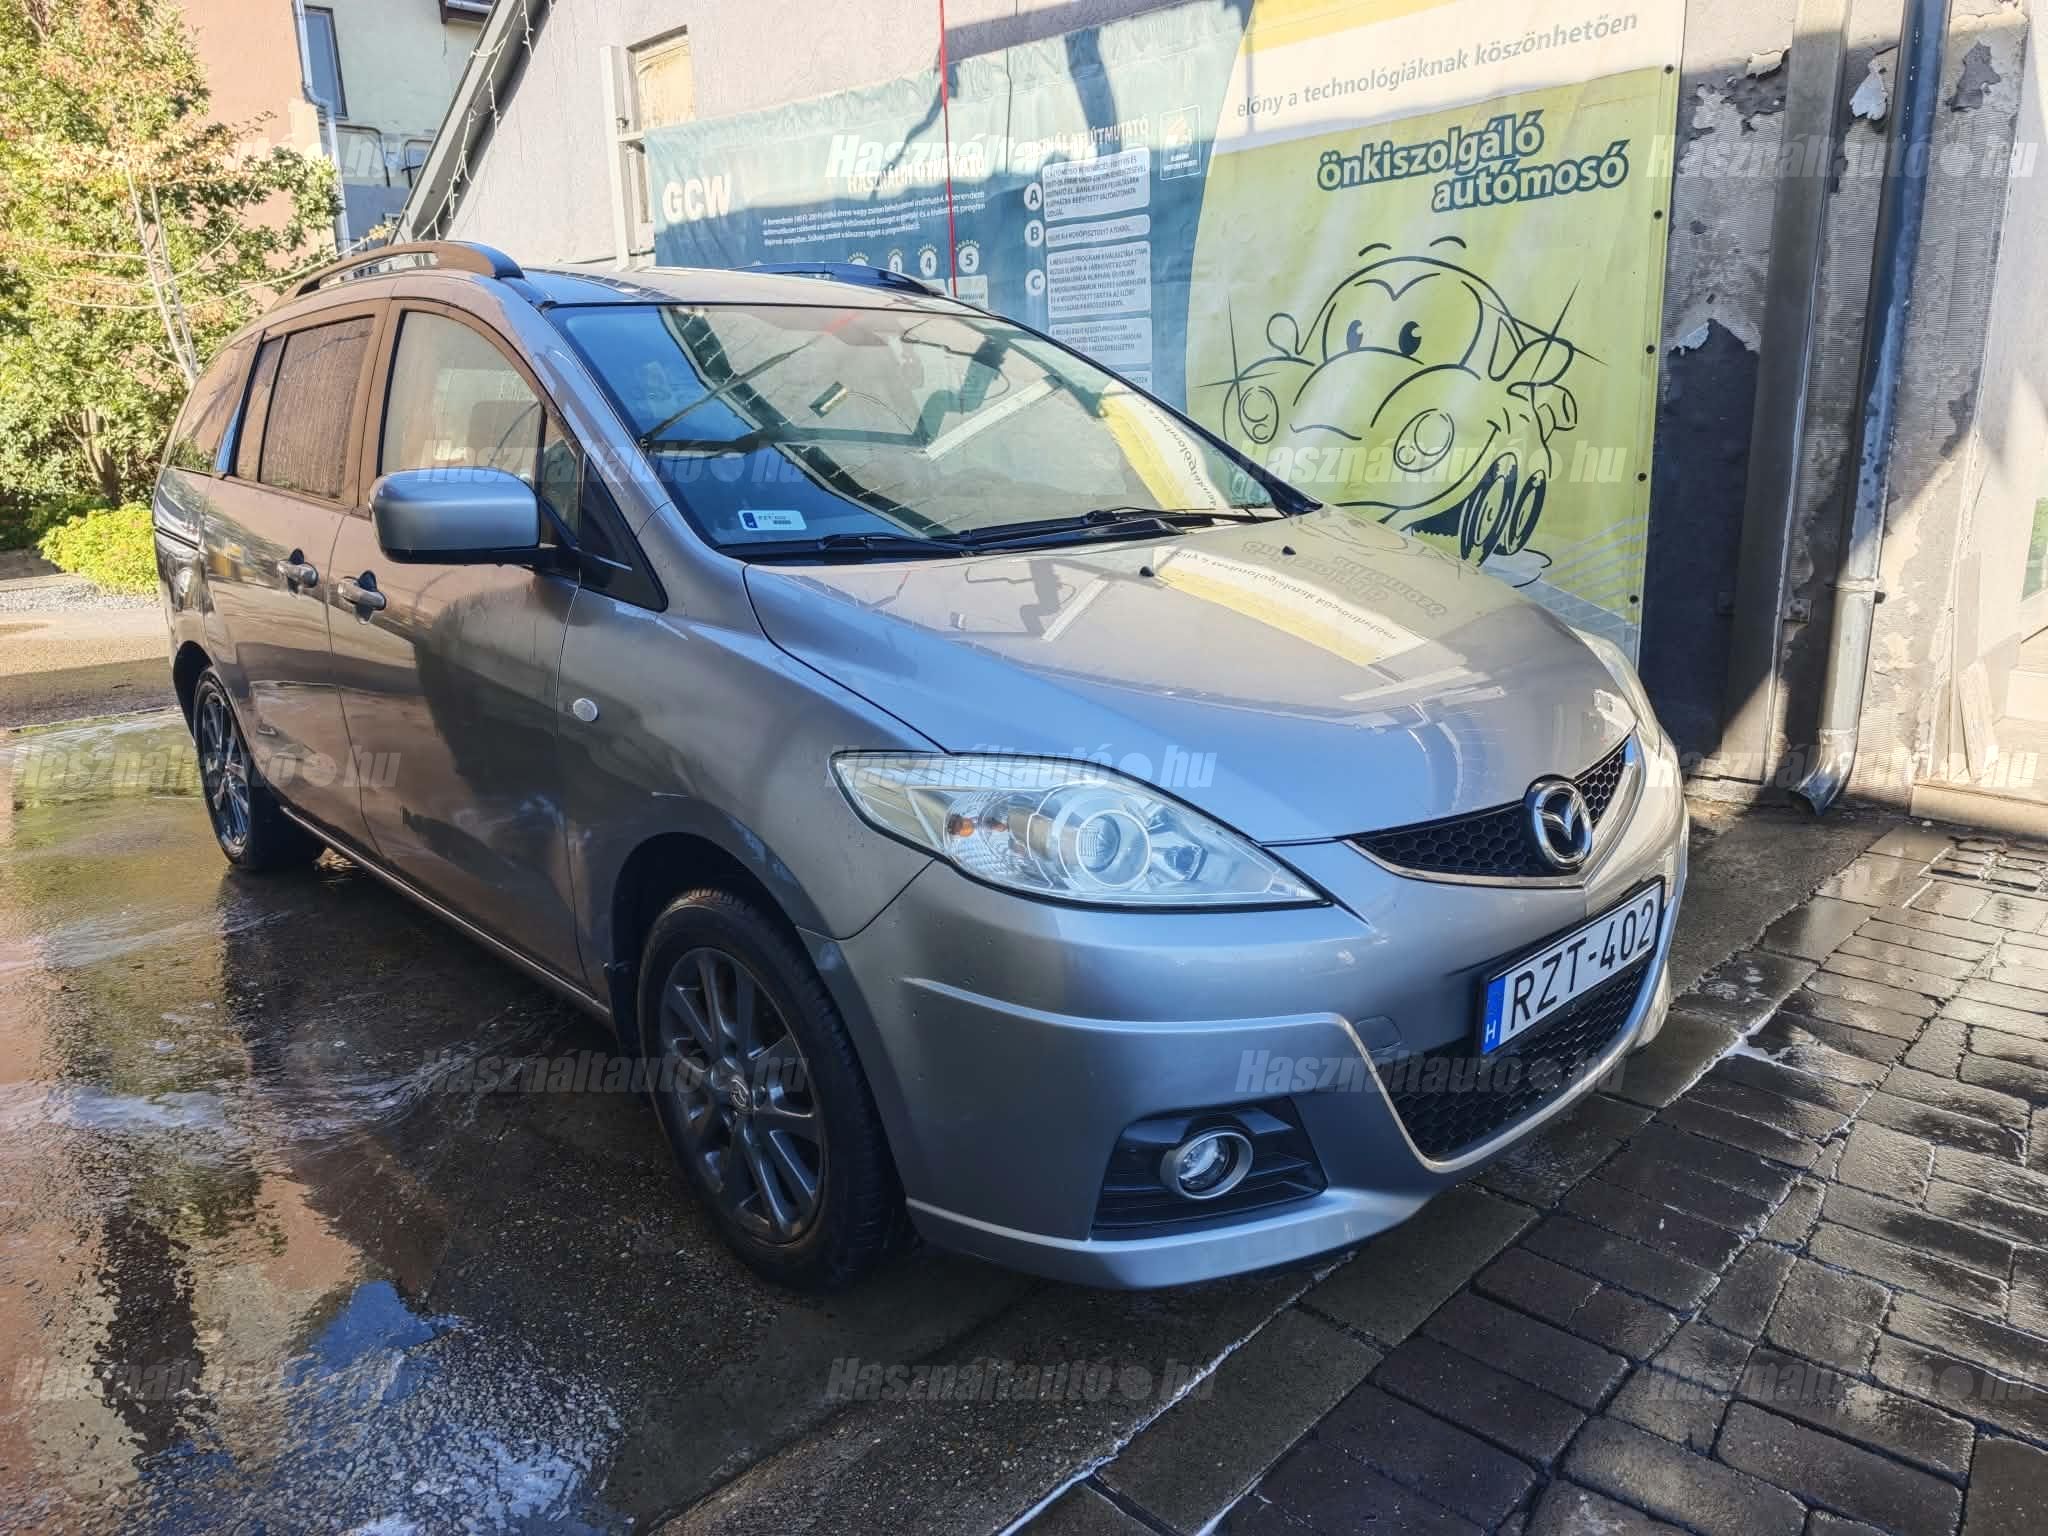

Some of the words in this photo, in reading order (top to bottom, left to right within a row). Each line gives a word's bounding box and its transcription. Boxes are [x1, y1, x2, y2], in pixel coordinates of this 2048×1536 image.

[1237, 92, 1284, 118] előny
[1287, 92, 1298, 107] a
[1303, 48, 1469, 104] technológiáknak
[1473, 12, 1638, 66] köszönhetően
[1317, 110, 1545, 191] önkiszolgáló
[1431, 139, 1631, 212] autómosó
[662, 173, 731, 225] GCW
[1028, 189, 1040, 205] A
[1029, 226, 1041, 241] B
[1030, 275, 1042, 290] C
[1510, 898, 1656, 1031] RZT-402
[1484, 1018, 1497, 1044] H
